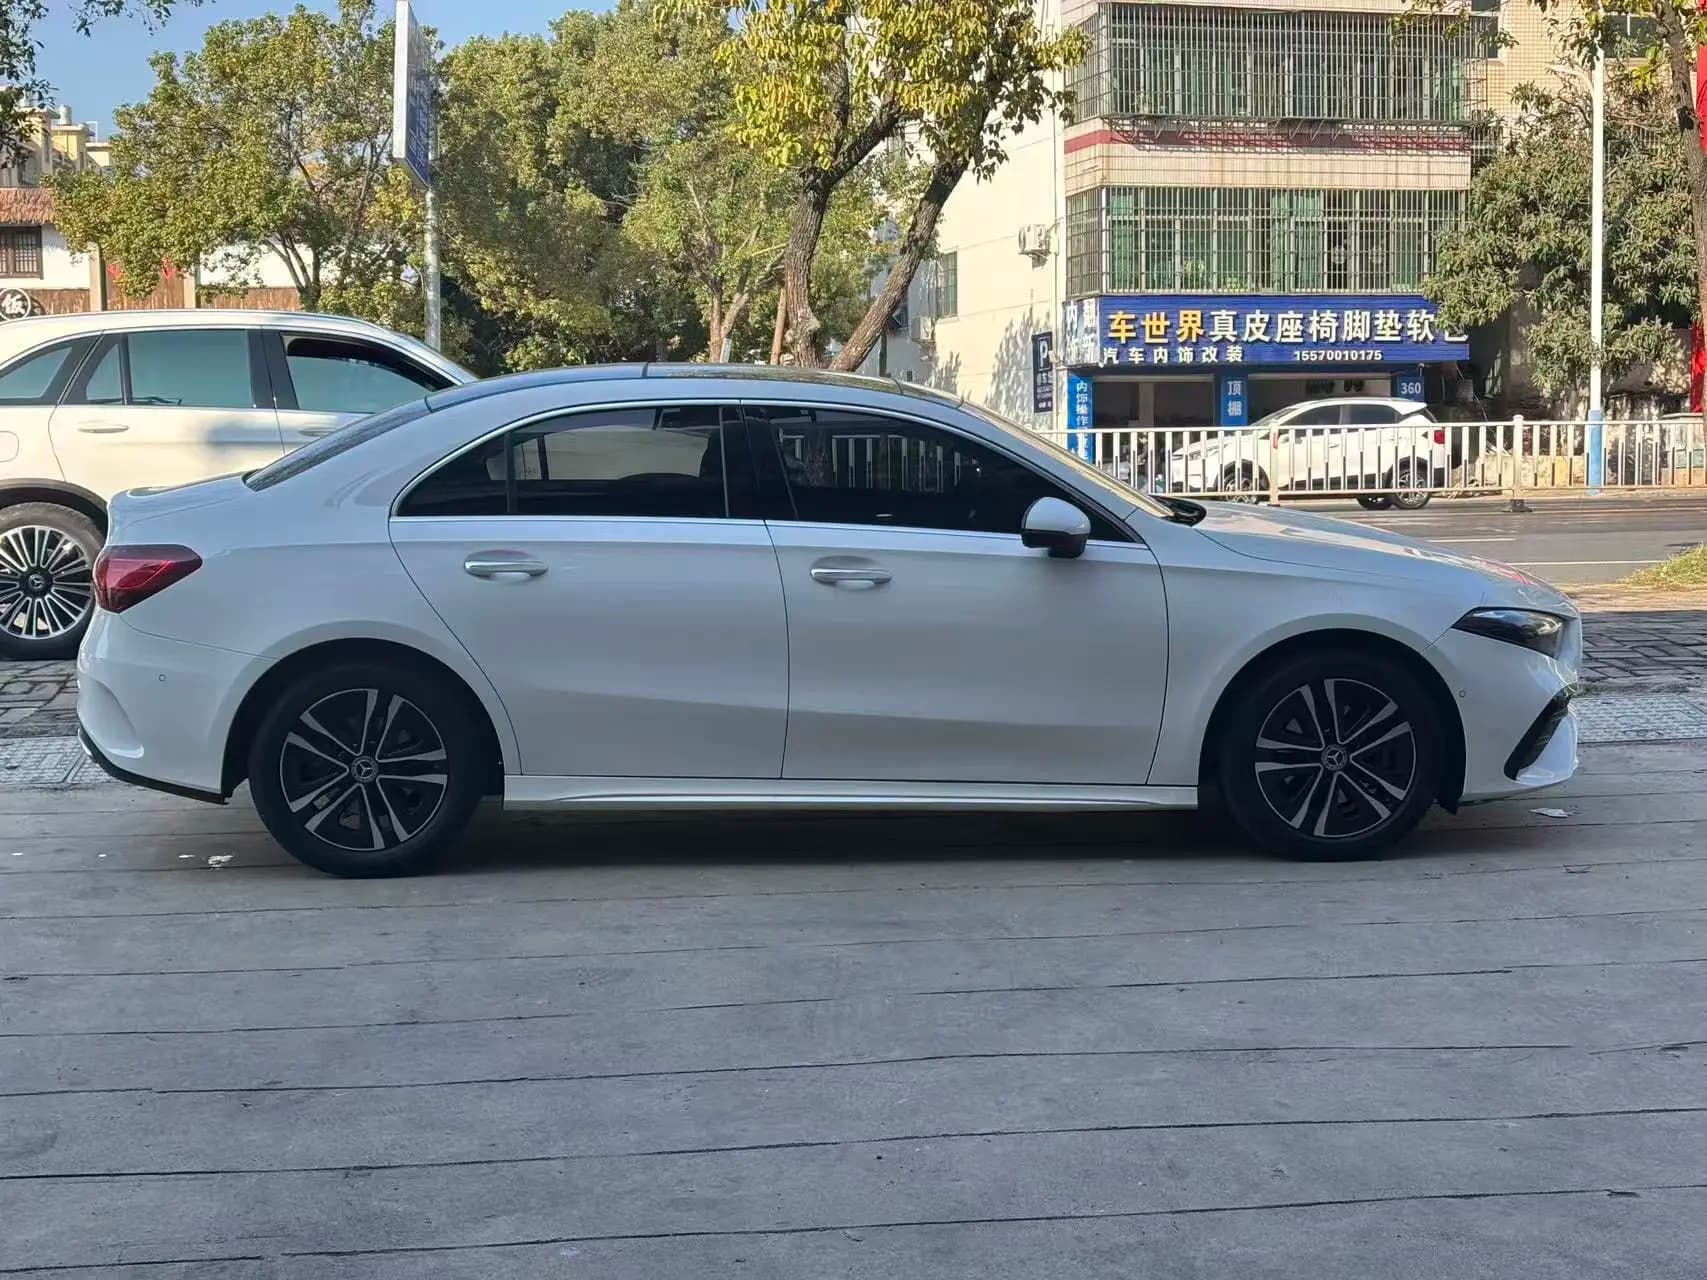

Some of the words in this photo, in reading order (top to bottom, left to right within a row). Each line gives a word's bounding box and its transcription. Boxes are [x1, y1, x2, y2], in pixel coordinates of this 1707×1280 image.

[1040, 341, 1048, 367] P
[1103, 346, 1243, 364] 汽车内饰改装
[1294, 350, 1383, 361] 15570010175
[1401, 382, 1421, 394] 360
[1227, 380, 1242, 416] 顶棚
